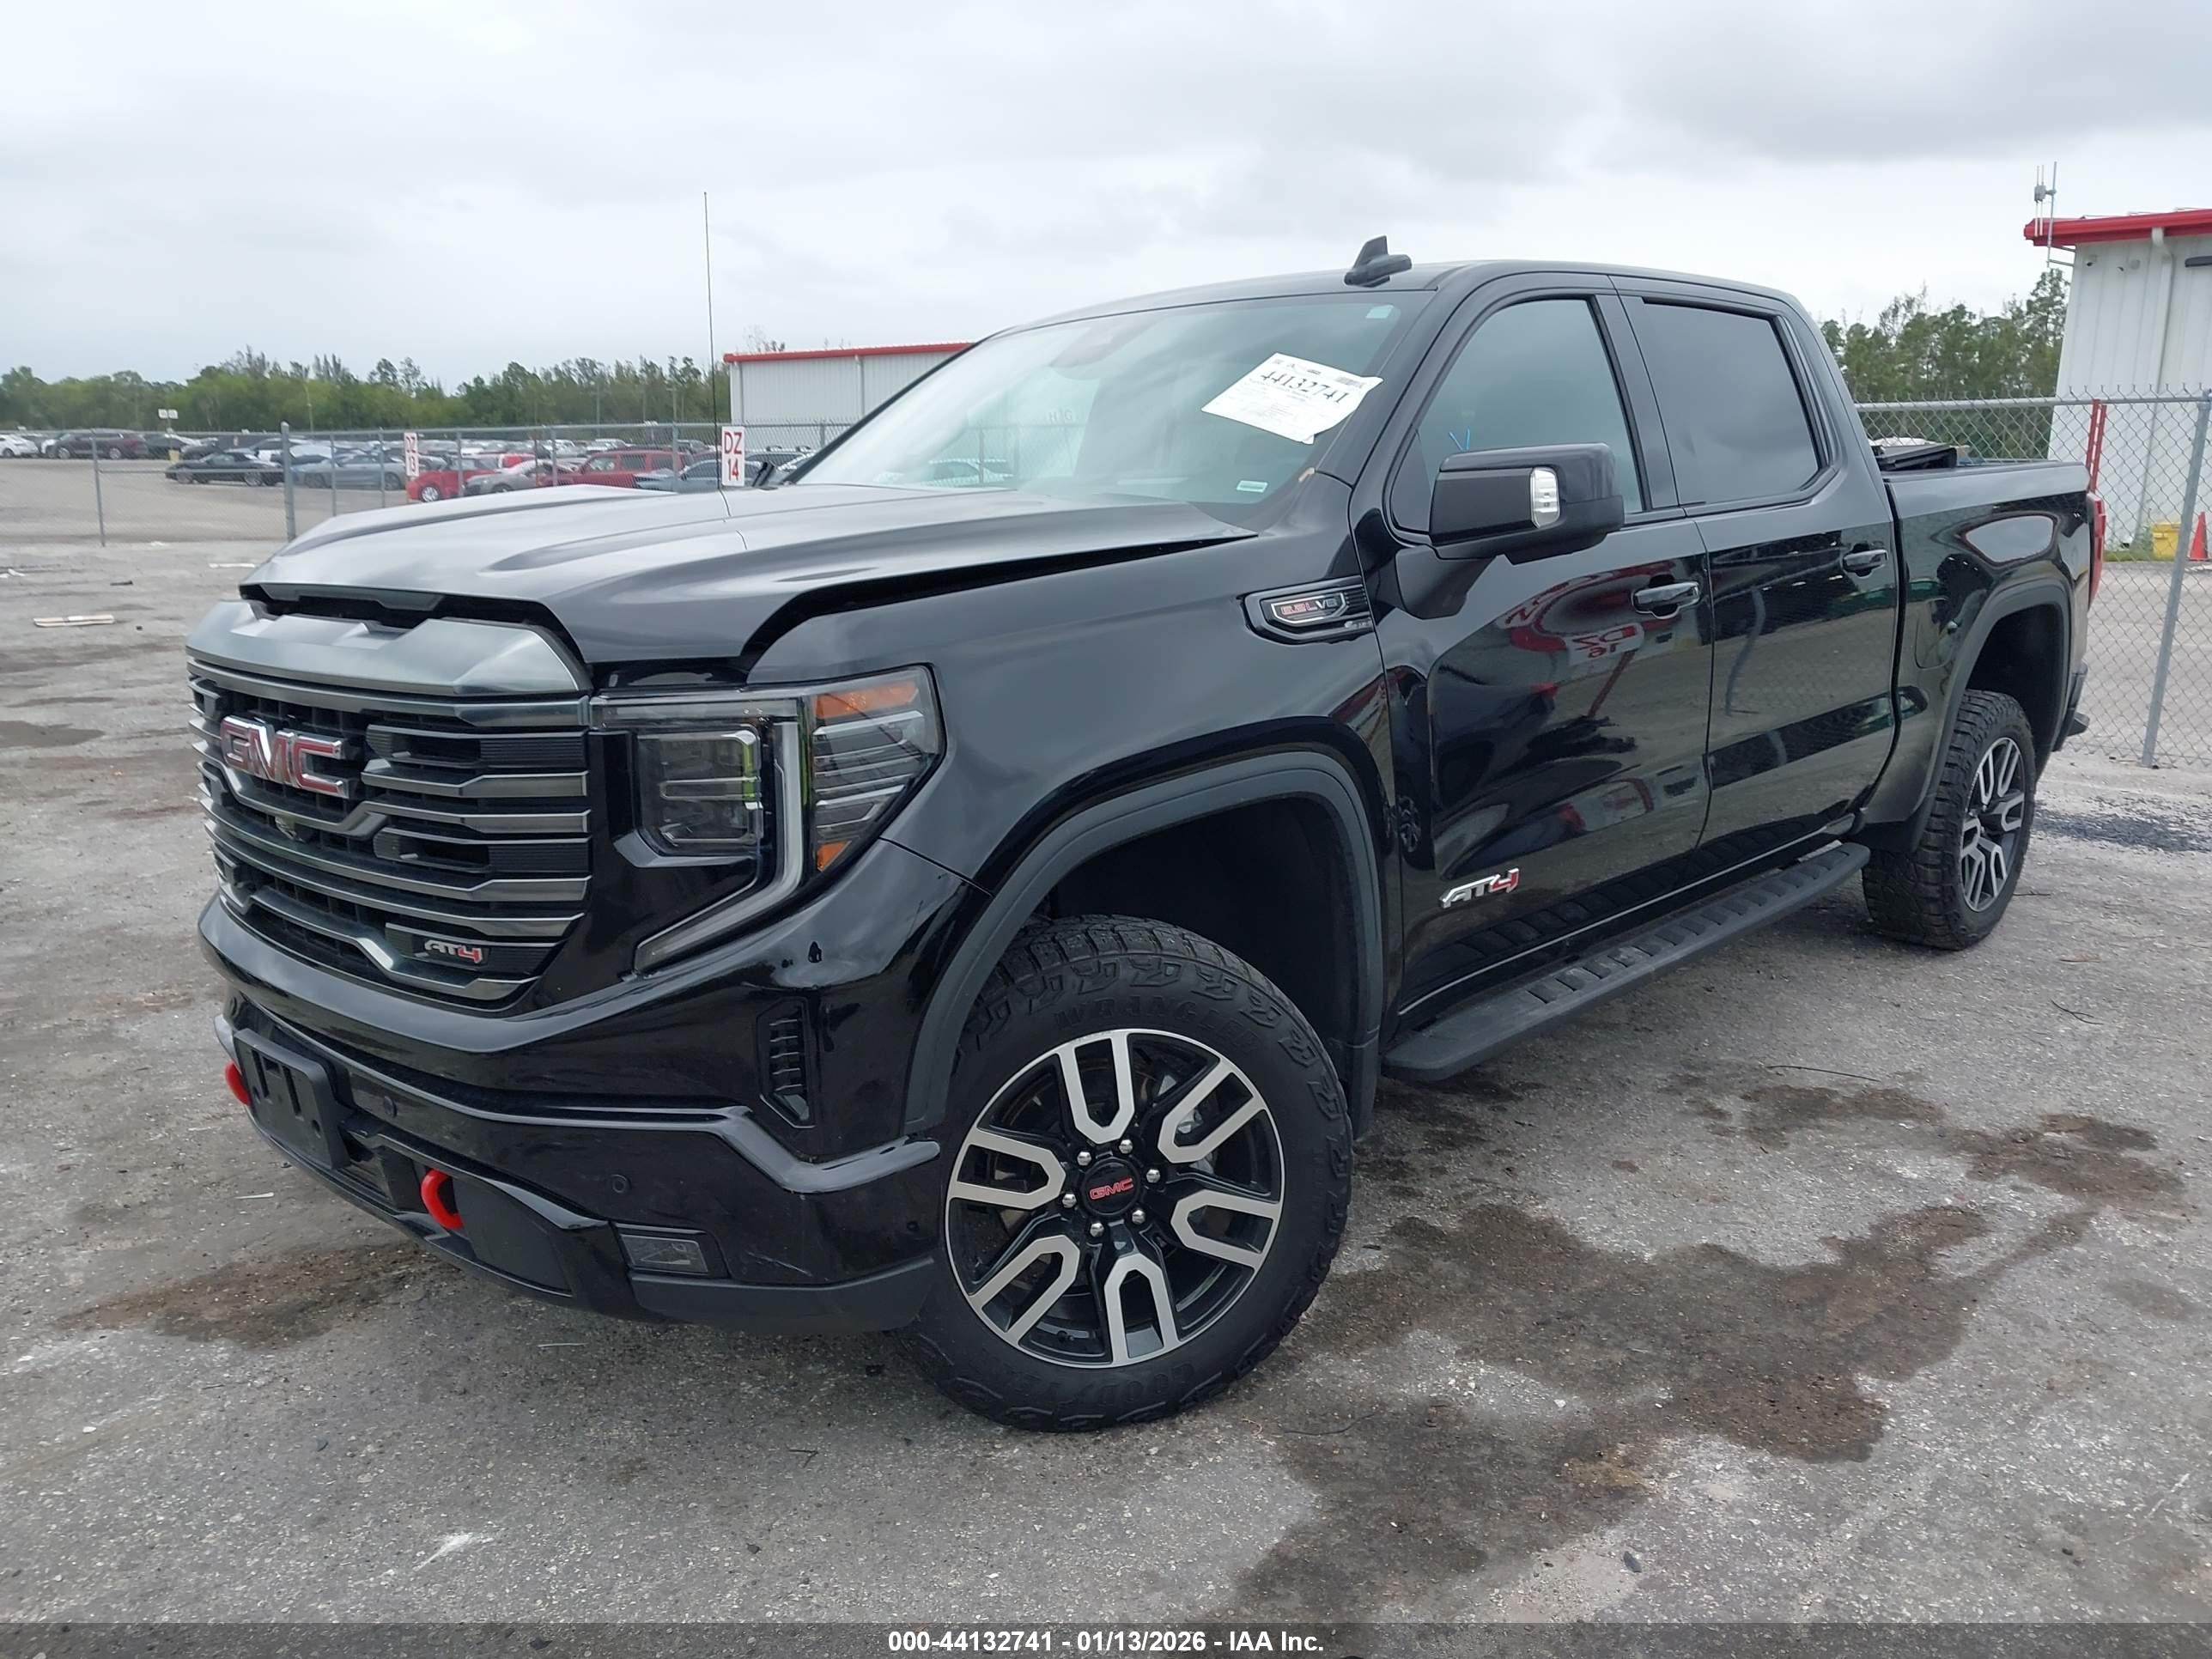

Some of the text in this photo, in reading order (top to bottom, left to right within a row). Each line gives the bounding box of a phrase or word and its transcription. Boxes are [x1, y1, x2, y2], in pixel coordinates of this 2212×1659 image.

[724, 431, 742, 454] DZ
[728, 458, 739, 481] 14
[220, 716, 350, 799] GMC
[1439, 868, 1519, 908] AT4
[424, 939, 483, 963] AT4
[1090, 1177, 1133, 1200] GMC
